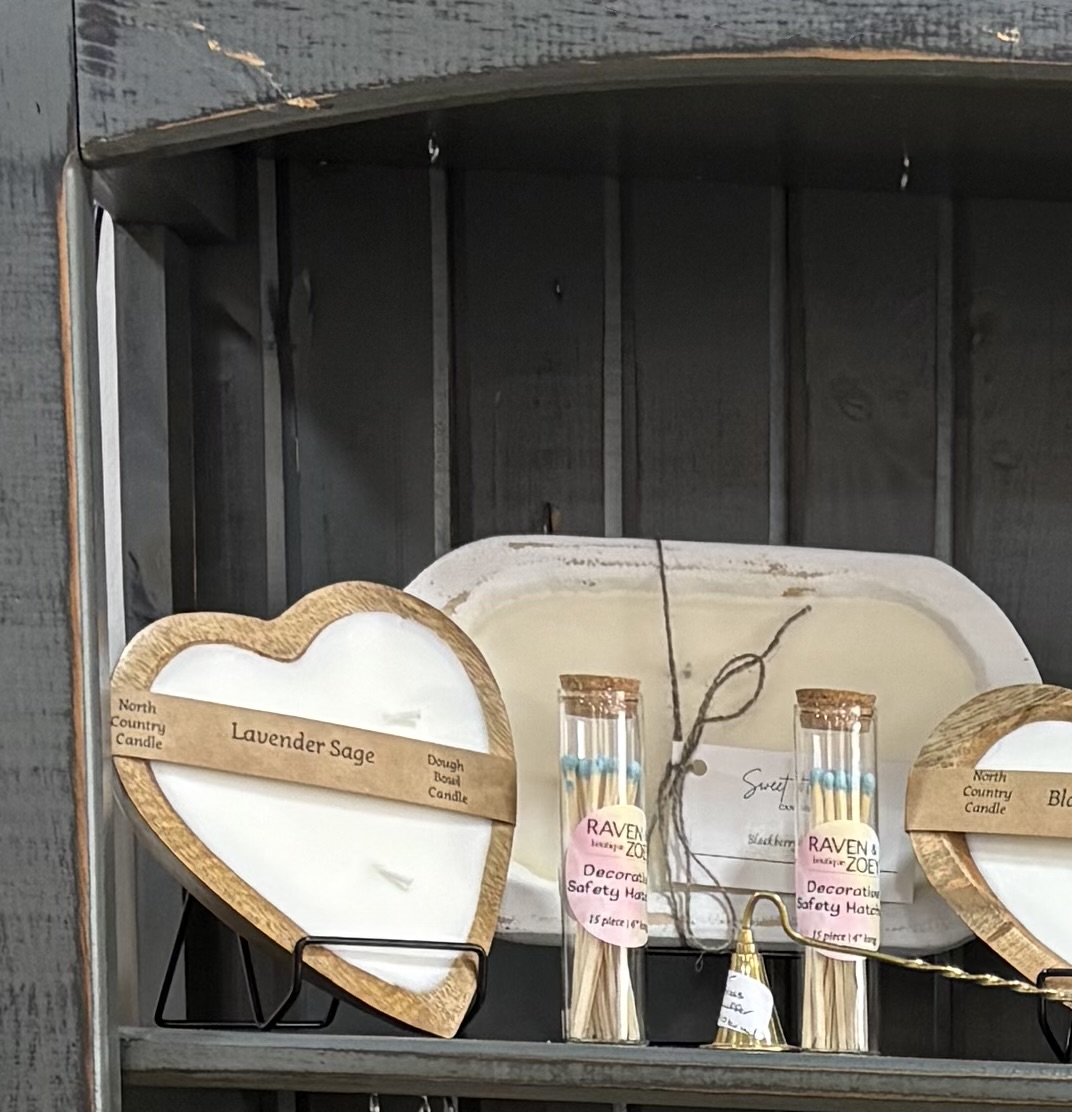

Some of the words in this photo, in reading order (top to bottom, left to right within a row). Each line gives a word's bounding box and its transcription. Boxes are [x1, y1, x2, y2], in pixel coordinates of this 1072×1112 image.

[119, 698, 156, 715] North
[110, 715, 166, 736] Country
[116, 732, 163, 750] Candle
[231, 722, 325, 755] Lavender
[330, 740, 375, 766] Sage
[427, 753, 464, 773] Dough
[973, 770, 1007, 783] North
[428, 786, 468, 805] Candle
[963, 785, 1013, 802] Country
[964, 801, 1006, 815] Candle
[587, 819, 644, 841] RAVEN
[747, 832, 795, 853] Blackberr
[808, 835, 868, 856] RAVEN
[567, 880, 620, 901] Safety
[797, 897, 840, 917] Safety
